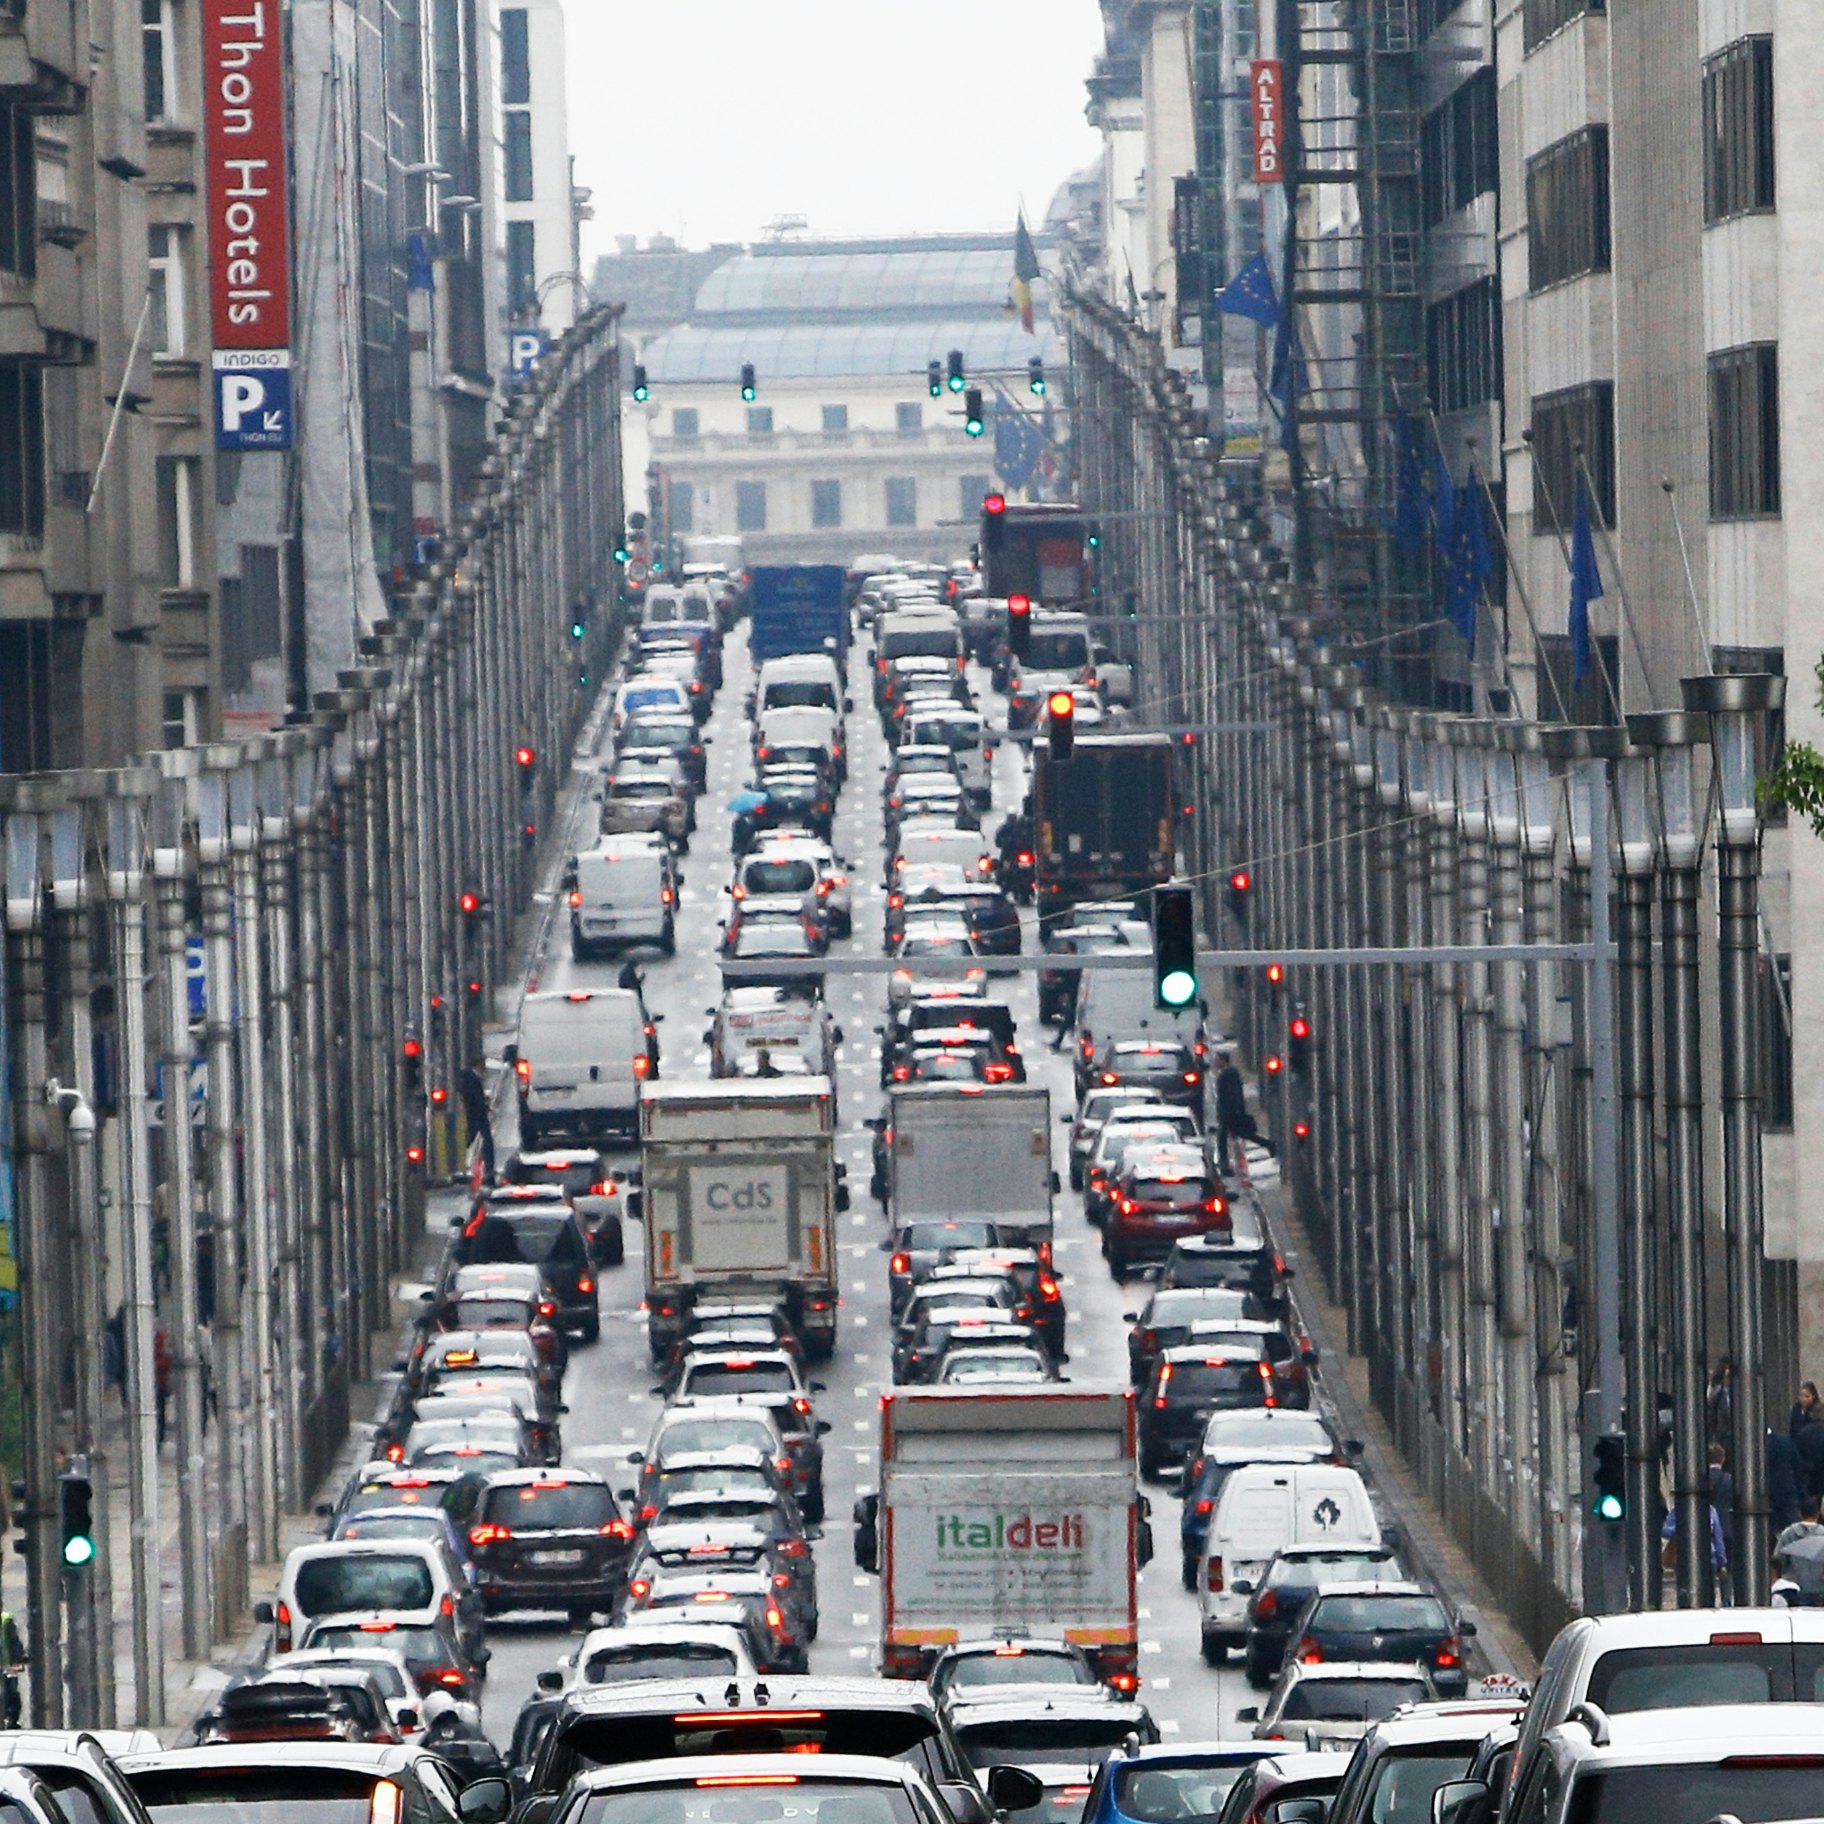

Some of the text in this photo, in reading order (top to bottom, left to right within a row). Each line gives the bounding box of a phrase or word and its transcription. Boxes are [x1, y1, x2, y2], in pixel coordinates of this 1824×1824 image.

[1257, 68, 1277, 172] ALTRAD
[218, 2, 273, 326] Thon Hotels
[223, 353, 280, 366] INDIGO
[512, 333, 540, 369] P
[221, 374, 265, 432] P
[706, 1181, 772, 1210] CdS
[936, 1514, 1084, 1549] italdeli
